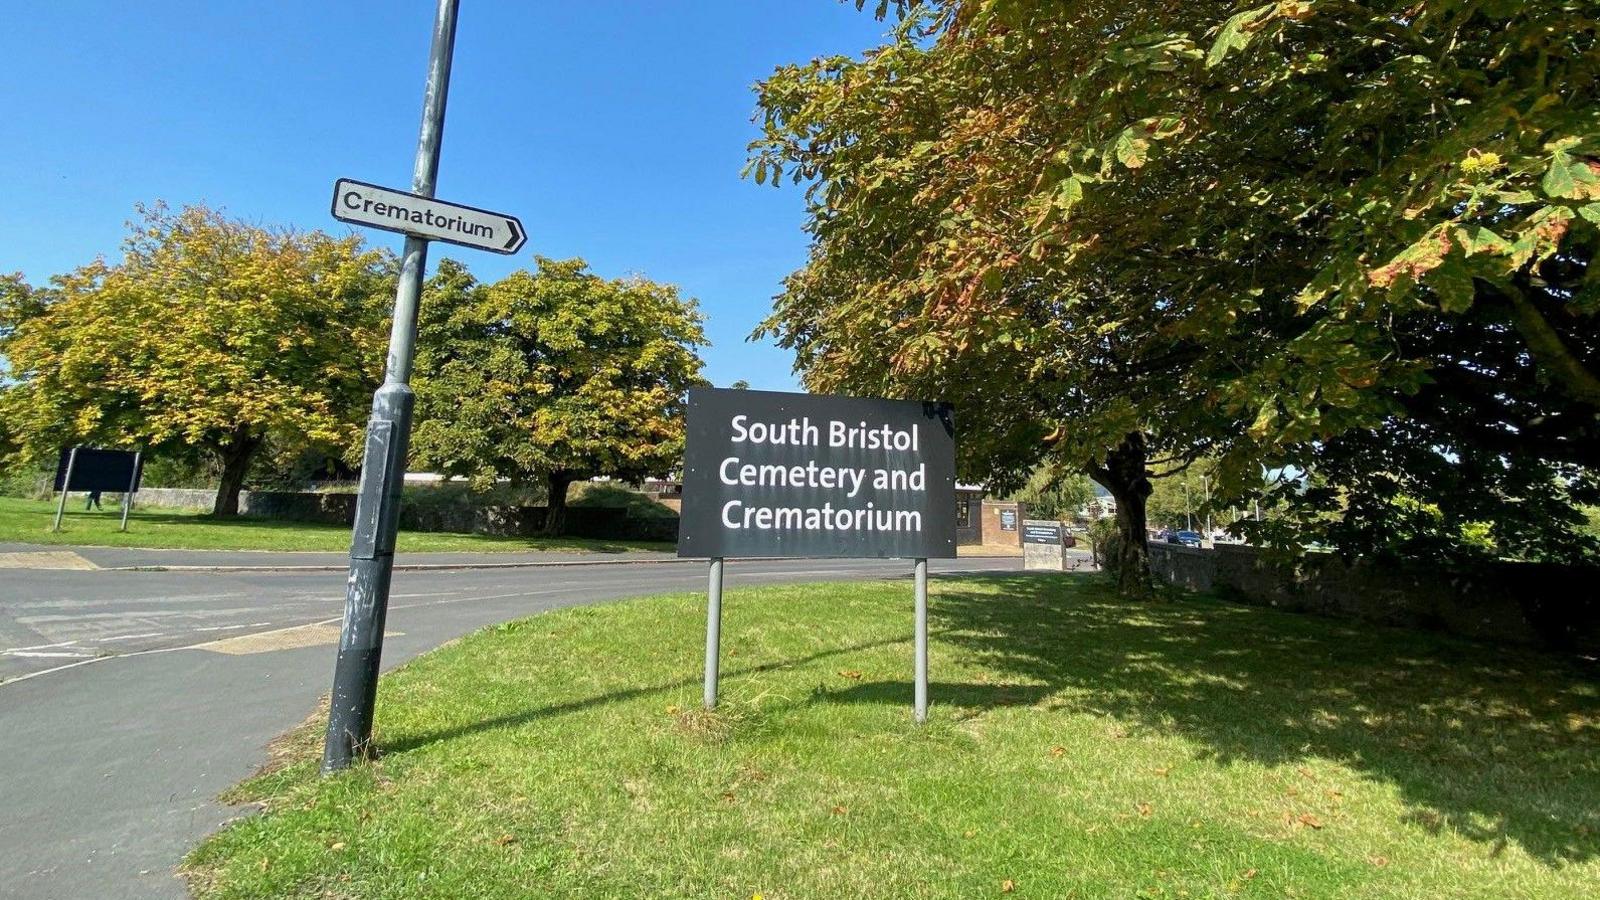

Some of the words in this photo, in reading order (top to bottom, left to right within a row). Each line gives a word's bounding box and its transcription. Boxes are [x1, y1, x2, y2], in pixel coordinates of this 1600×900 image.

[343, 191, 494, 239] Crematorium
[730, 414, 819, 447] South
[828, 420, 919, 452] Bristol
[719, 456, 866, 498] Cemetery
[872, 462, 926, 492] and
[721, 500, 922, 532] Crematorium
